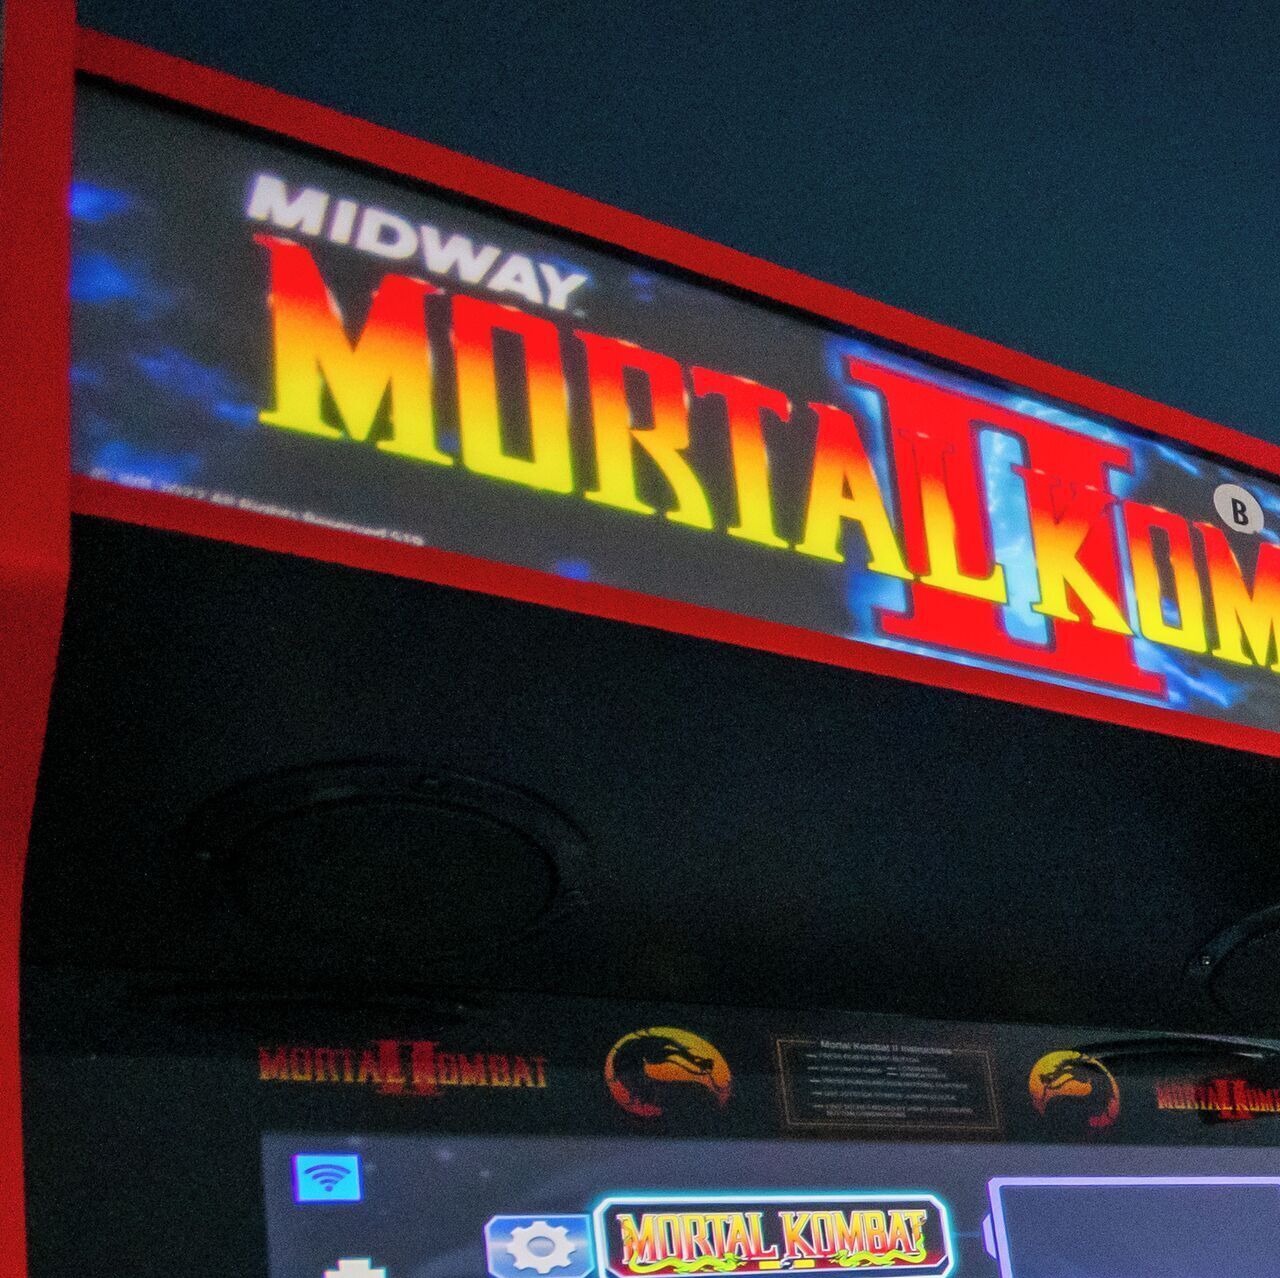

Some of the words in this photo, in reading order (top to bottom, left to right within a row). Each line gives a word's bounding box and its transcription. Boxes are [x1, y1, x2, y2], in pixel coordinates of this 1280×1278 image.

[246, 173, 587, 312] MIDWAY
[253, 233, 1007, 606] MORTAL
[1231, 497, 1248, 526] B
[258, 1044, 404, 1083] MORTAL
[411, 1048, 547, 1089] KOMBAT
[616, 1211, 779, 1263] MORTAL
[778, 1209, 927, 1260] KOMBAT
